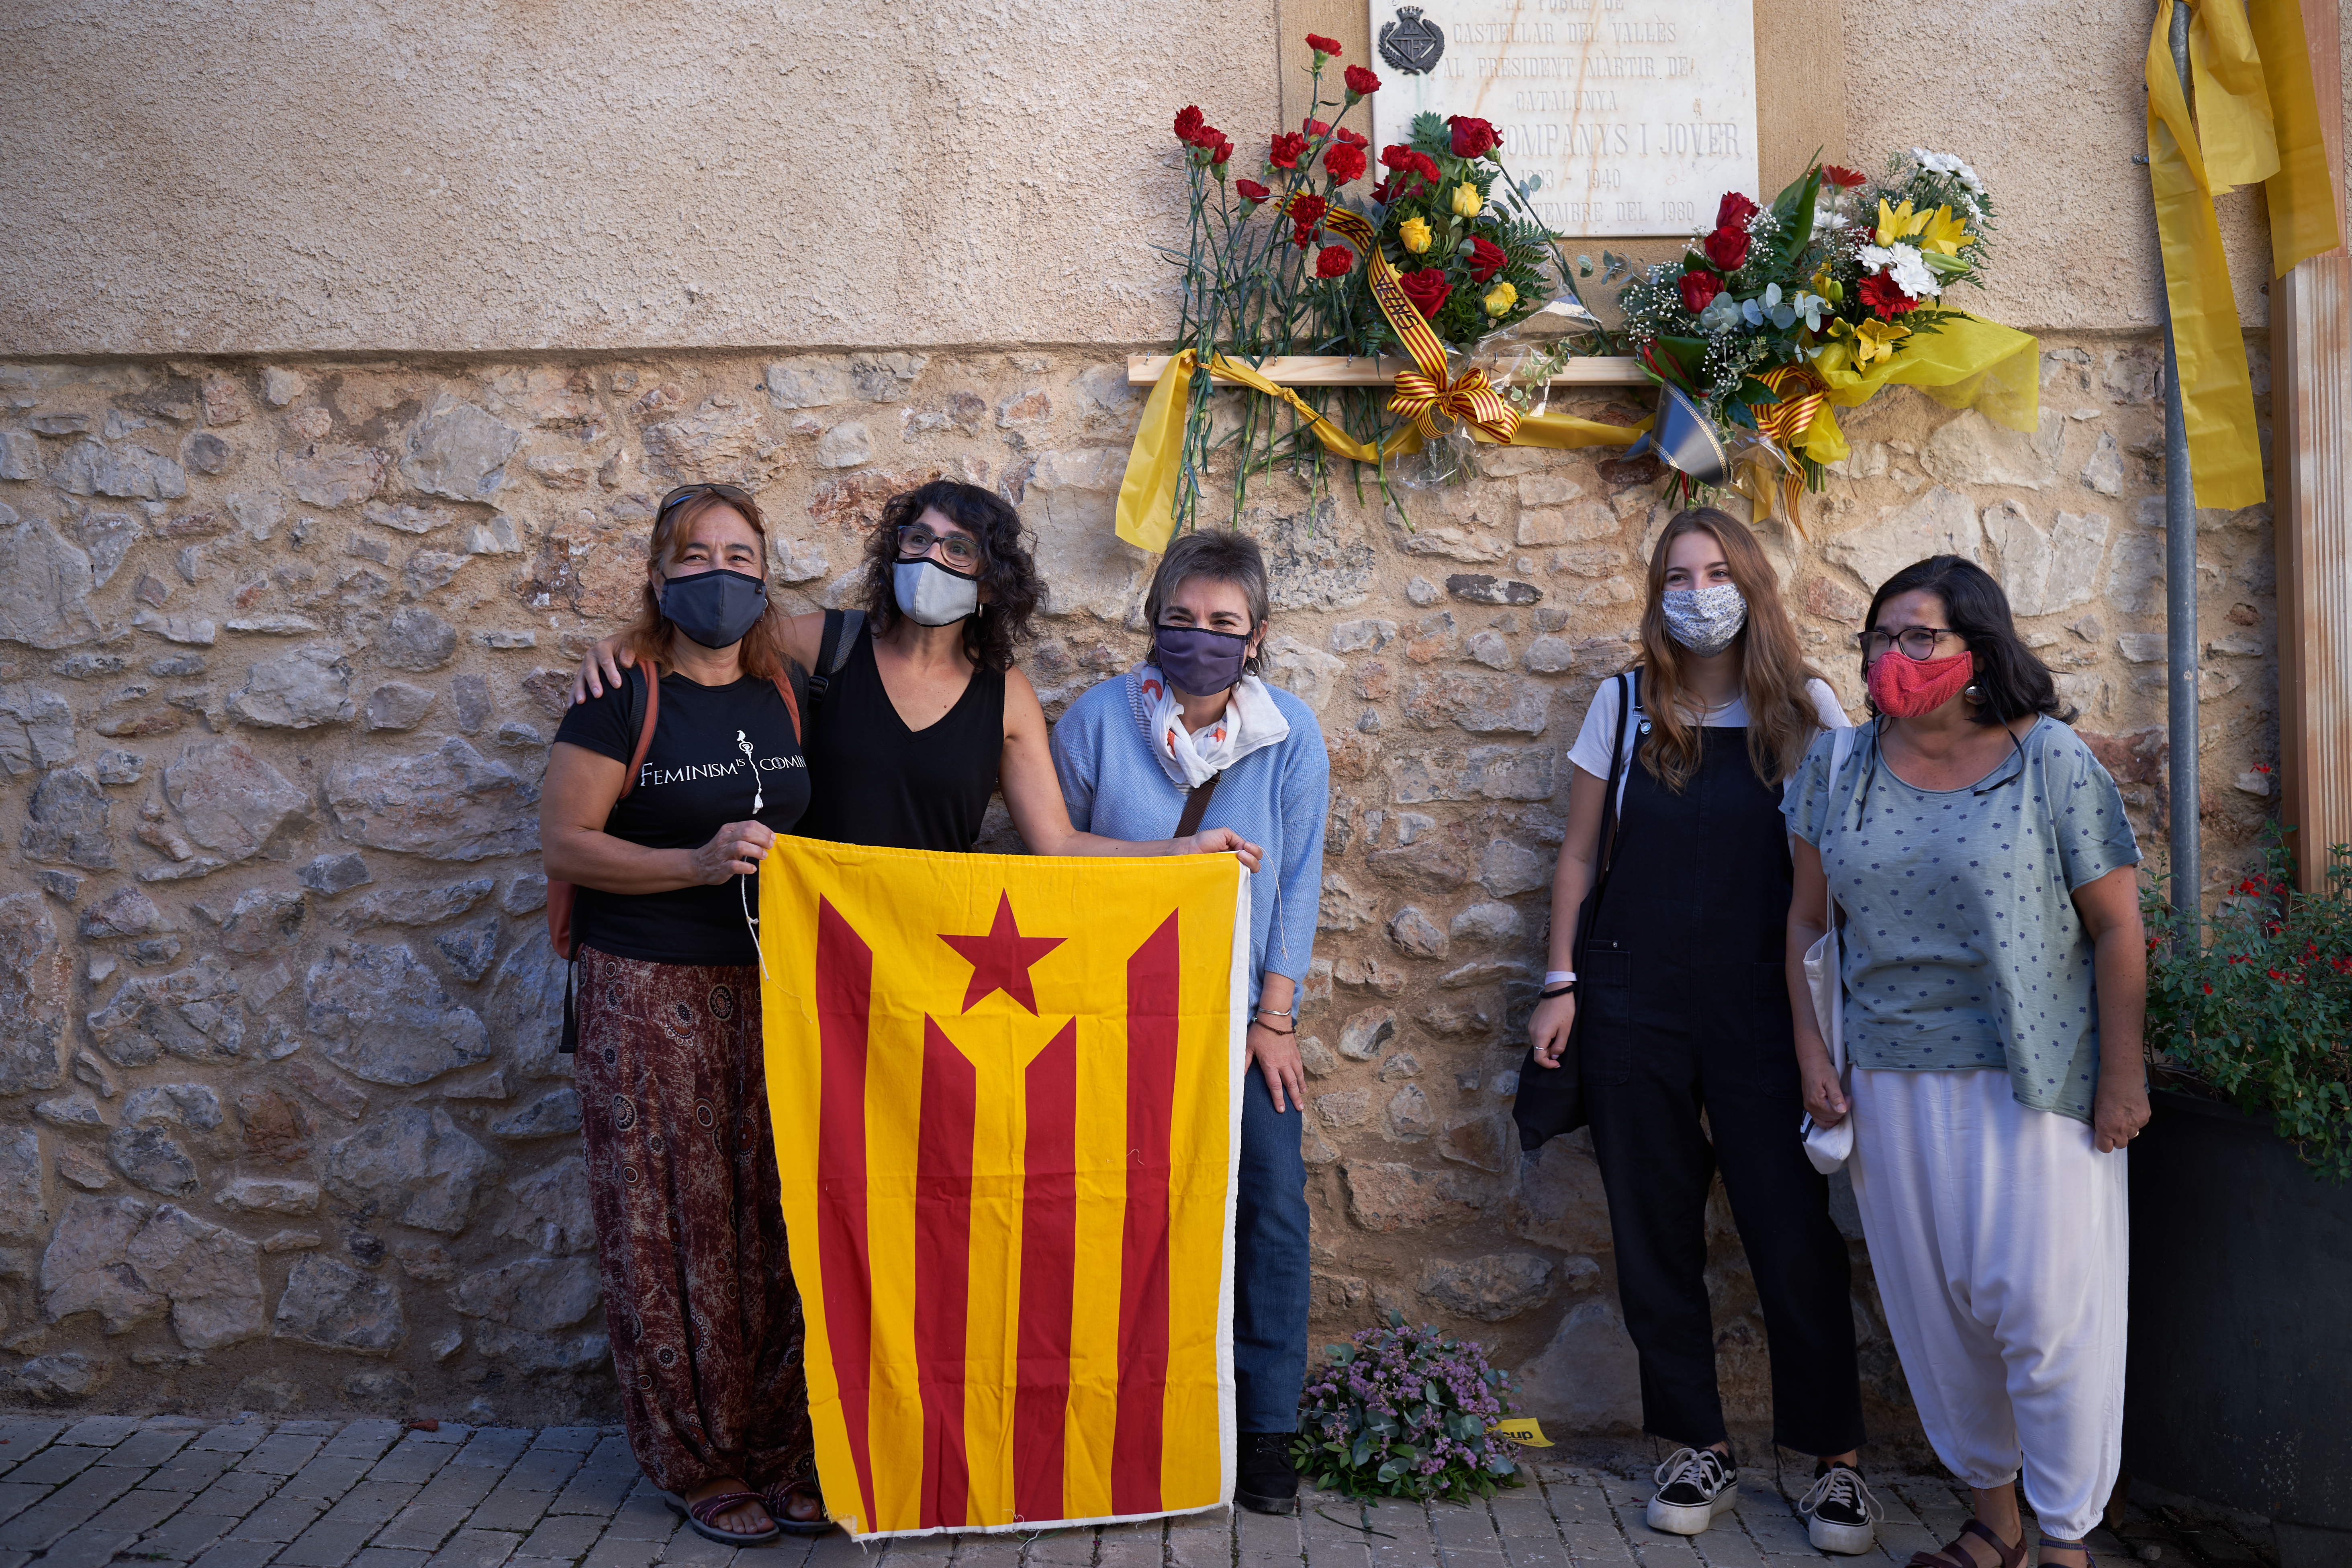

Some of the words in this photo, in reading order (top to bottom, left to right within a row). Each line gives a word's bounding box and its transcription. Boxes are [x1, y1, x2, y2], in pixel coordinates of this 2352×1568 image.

[1453, 23, 1555, 43] CASTELLAR
[1567, 23, 1599, 43] DEL
[1611, 14, 1676, 43] VALLÈS
[1444, 57, 1464, 78] AL
[1477, 57, 1573, 78] PRESIDENT
[1586, 49, 1655, 77] MÀRTIR
[1667, 57, 1688, 77] DE
[1516, 91, 1618, 111] CATALUNYA
[1639, 123, 1647, 155] I
[1659, 123, 1739, 156] JOVER
[1586, 169, 1620, 189] 1940
[1615, 202, 1647, 221] DEL
[1661, 201, 1694, 221] 1980
[640, 762, 738, 786] FEMINISM
[735, 758, 746, 768] IS
